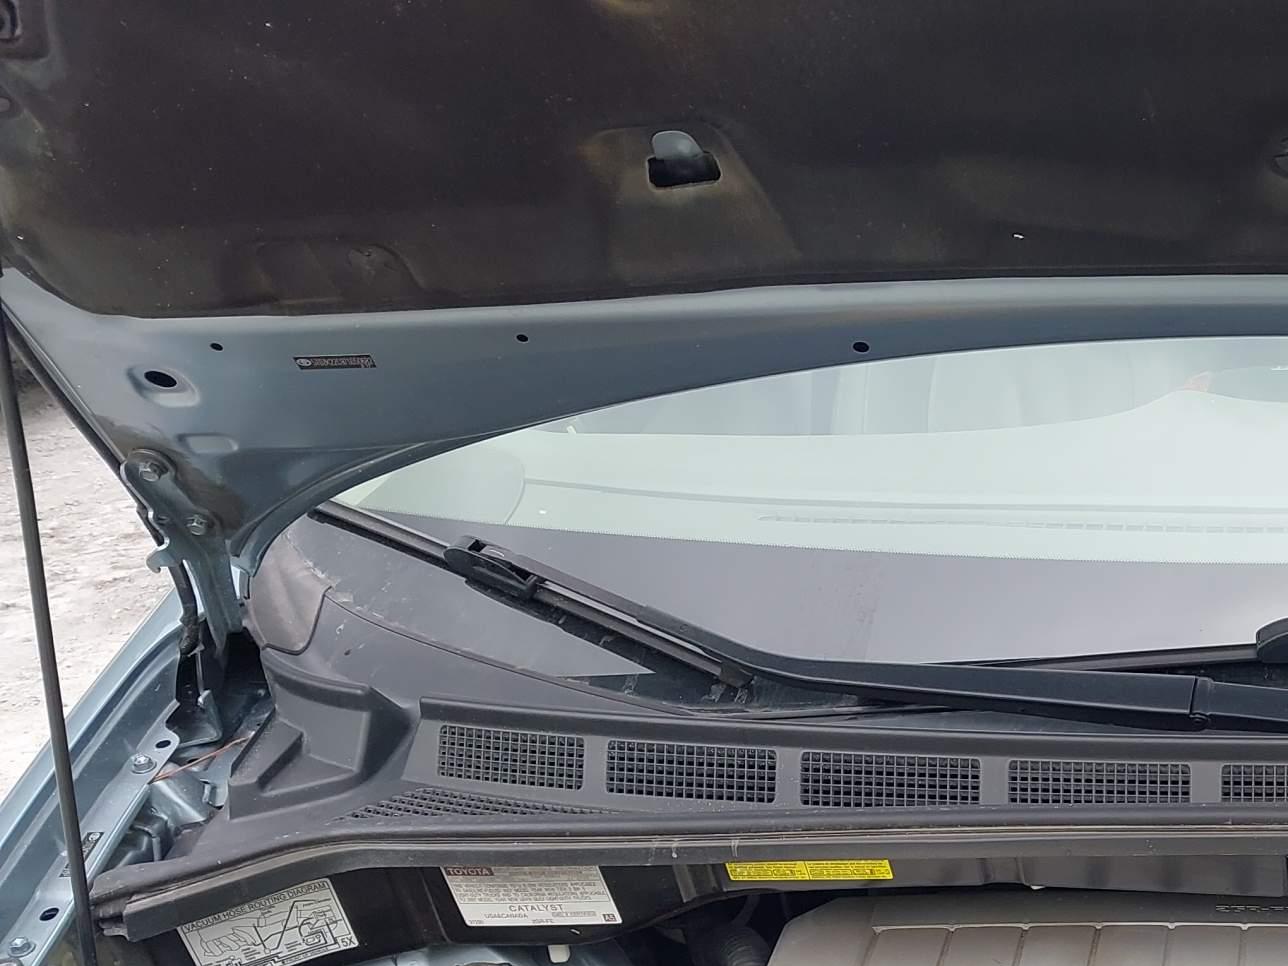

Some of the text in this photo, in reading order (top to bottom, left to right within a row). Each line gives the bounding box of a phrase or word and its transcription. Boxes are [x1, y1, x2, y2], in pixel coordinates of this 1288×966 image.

[446, 867, 491, 876] TOYOTA
[184, 882, 328, 932] VACUUM HOSE ROUTING DIAGRAM
[508, 904, 564, 912] CATALYST
[341, 937, 356, 948] 5X
